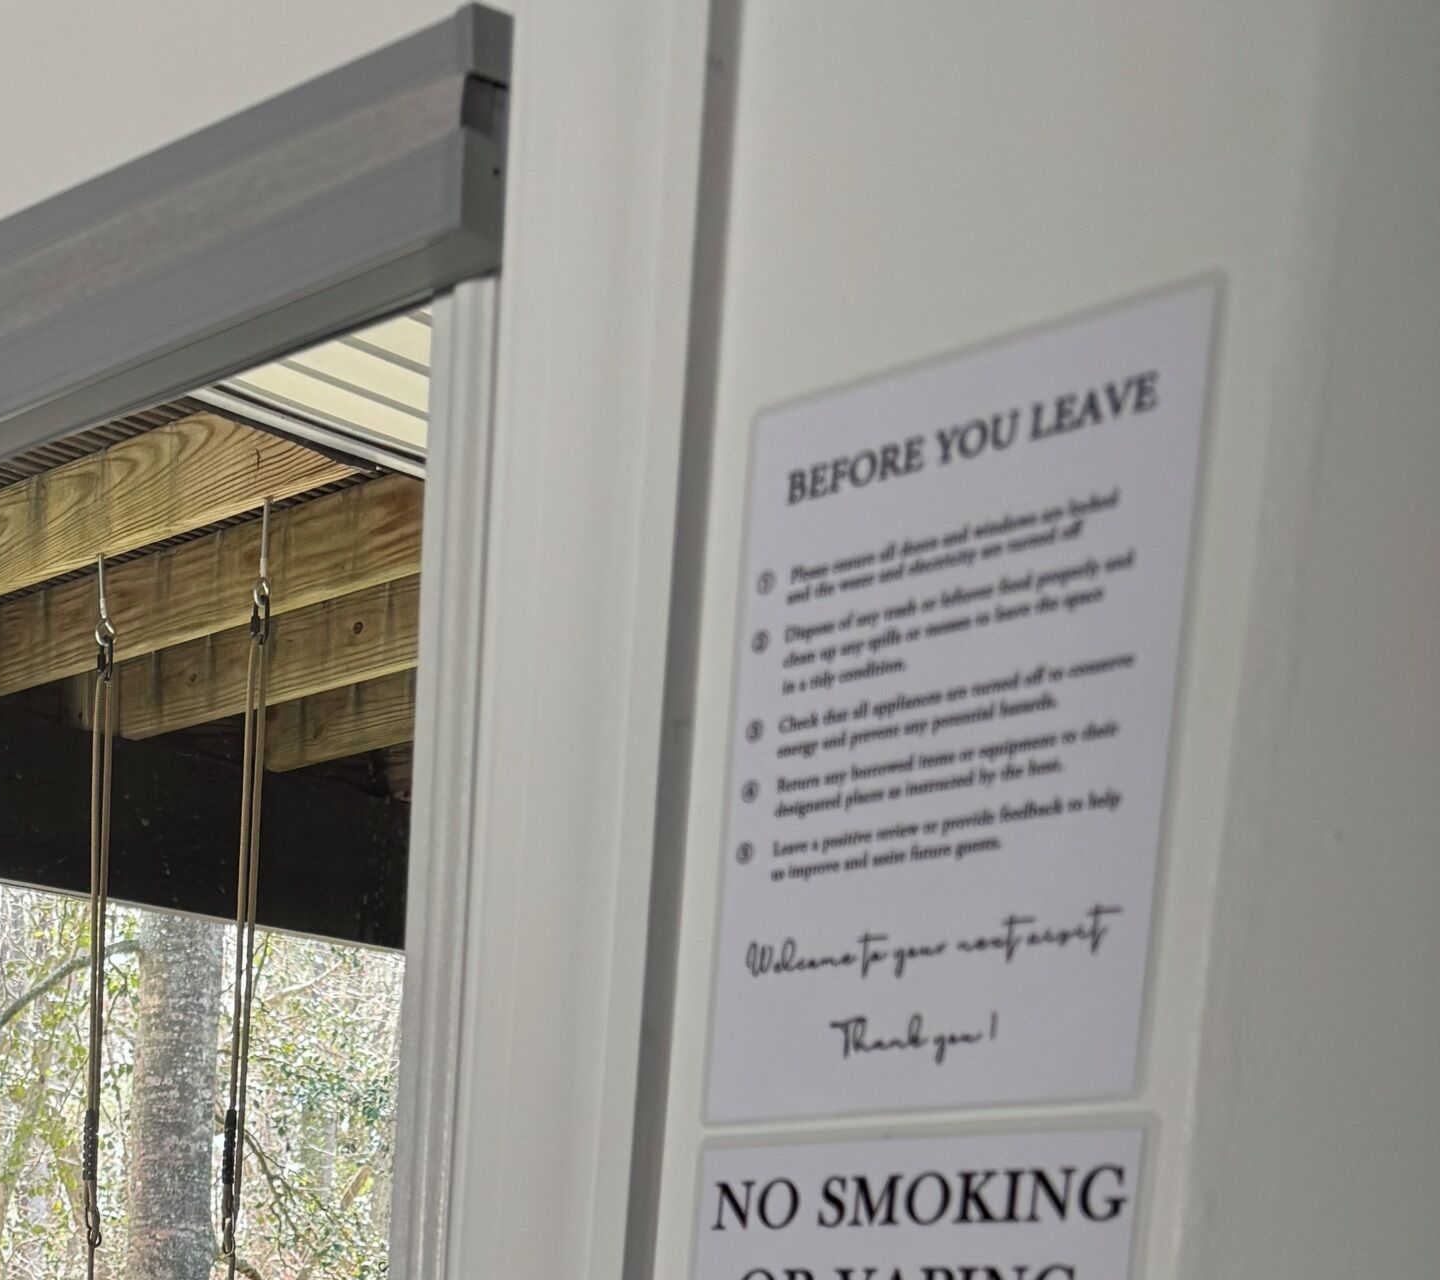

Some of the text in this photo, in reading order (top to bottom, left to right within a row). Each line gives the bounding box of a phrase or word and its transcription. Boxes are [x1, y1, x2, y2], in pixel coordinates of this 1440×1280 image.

[787, 370, 1158, 505] BEFORE YOU LEAVE
[745, 937, 856, 977] Welcome
[852, 931, 887, 978] to
[892, 942, 946, 978] your
[956, 914, 1034, 963] next
[829, 1011, 998, 1065] Thank you!
[711, 1163, 1130, 1231] NO SMOKING
